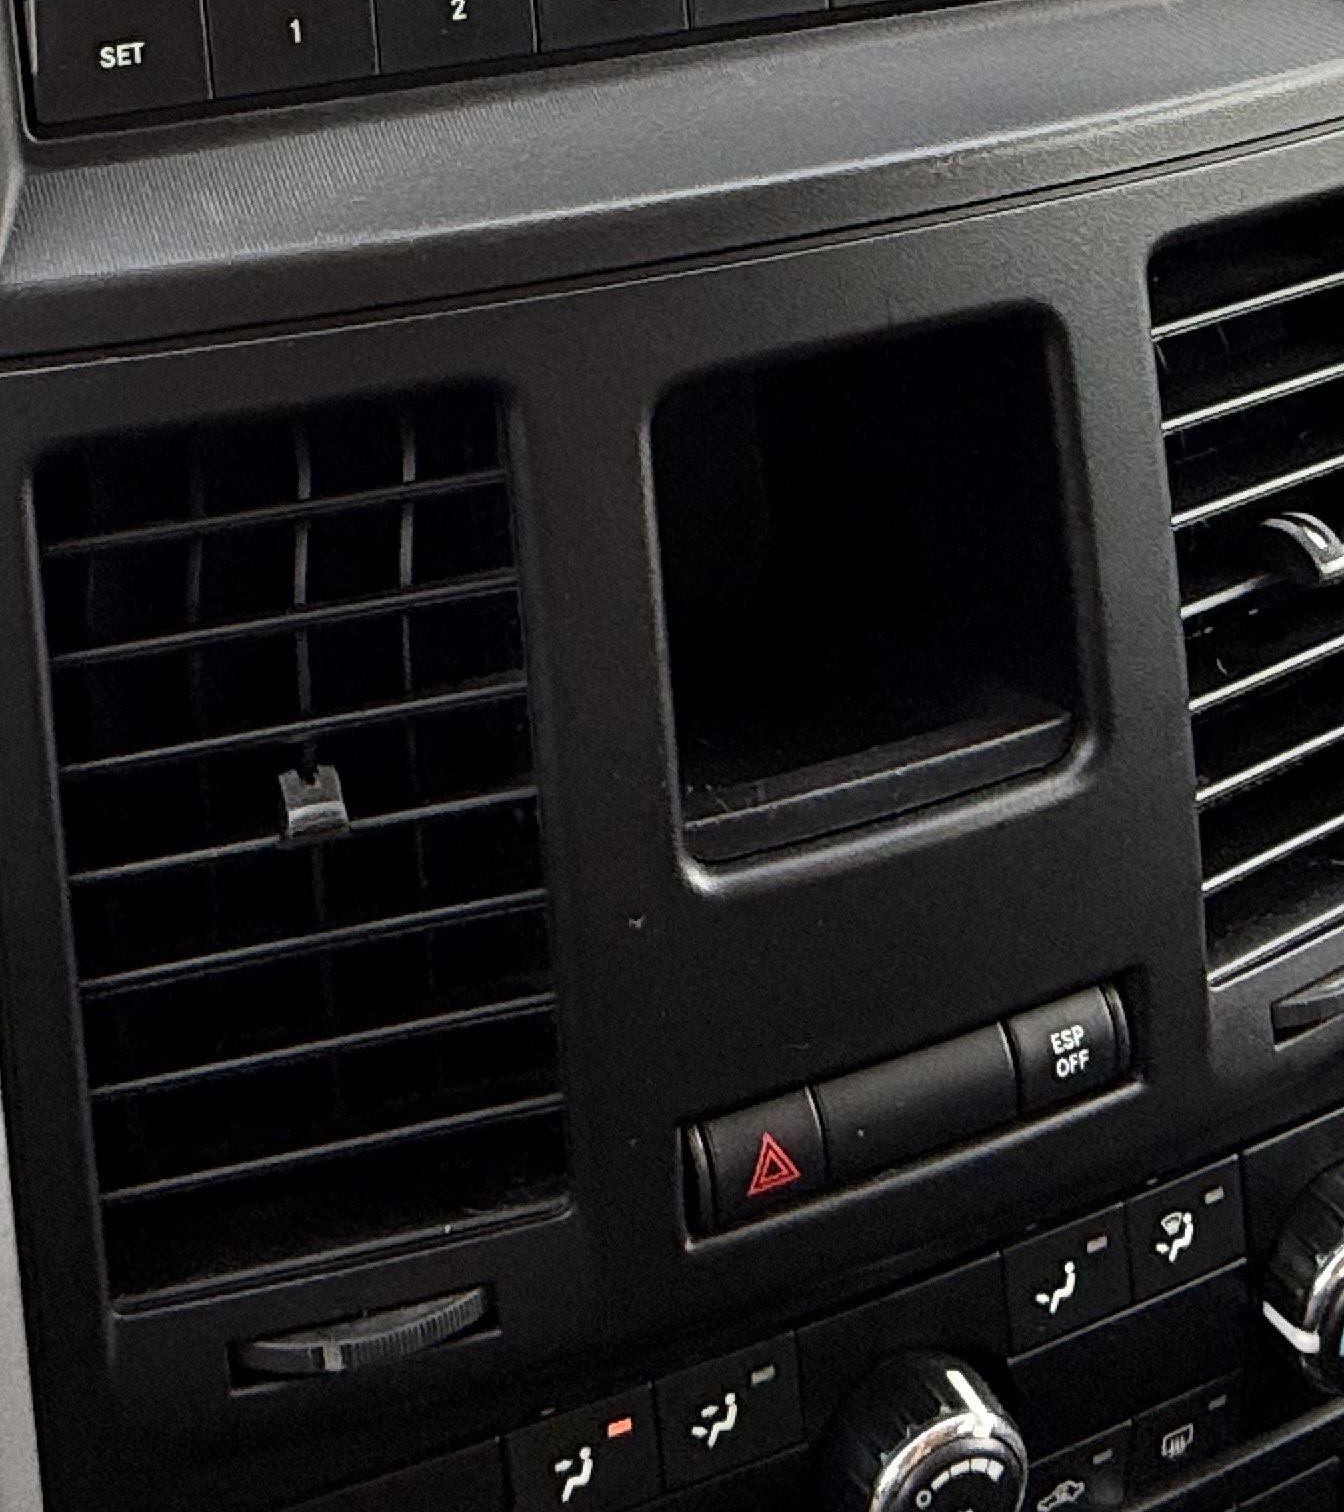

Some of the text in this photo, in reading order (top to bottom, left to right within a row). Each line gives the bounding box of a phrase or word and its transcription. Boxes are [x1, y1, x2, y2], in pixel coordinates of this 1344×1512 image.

[290, 18, 301, 44] 1
[99, 42, 145, 68] SET
[1050, 1024, 1085, 1055] ESP
[1055, 1047, 1090, 1078] OFF
